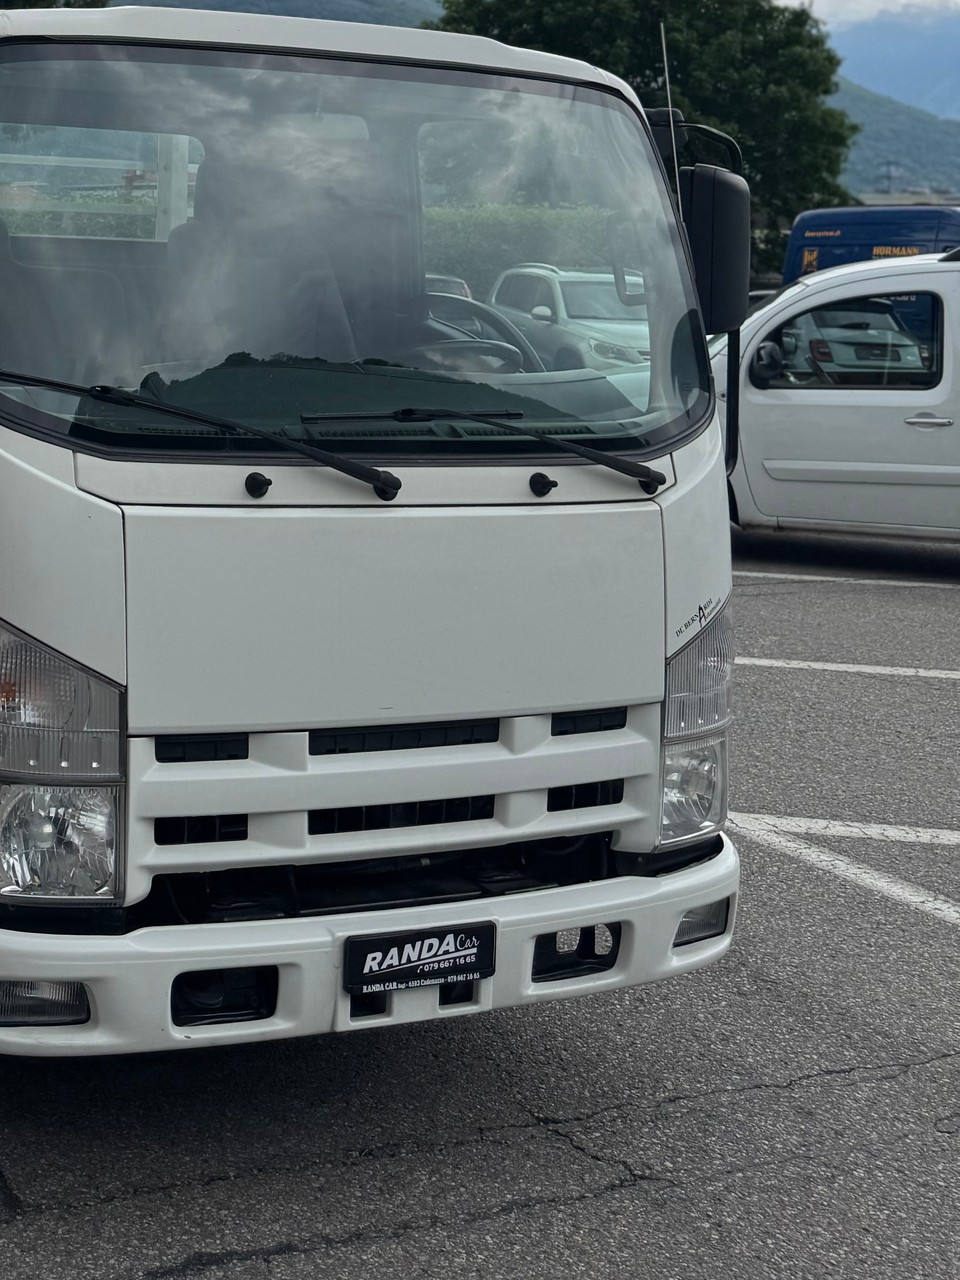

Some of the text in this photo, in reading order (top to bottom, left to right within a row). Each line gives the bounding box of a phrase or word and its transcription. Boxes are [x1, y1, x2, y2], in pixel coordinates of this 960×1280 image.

[363, 933, 480, 973] RANDA Car
[424, 954, 476, 971] 079 667 16 65
[362, 983, 384, 993] RANDA
[385, 981, 398, 990] CAR
